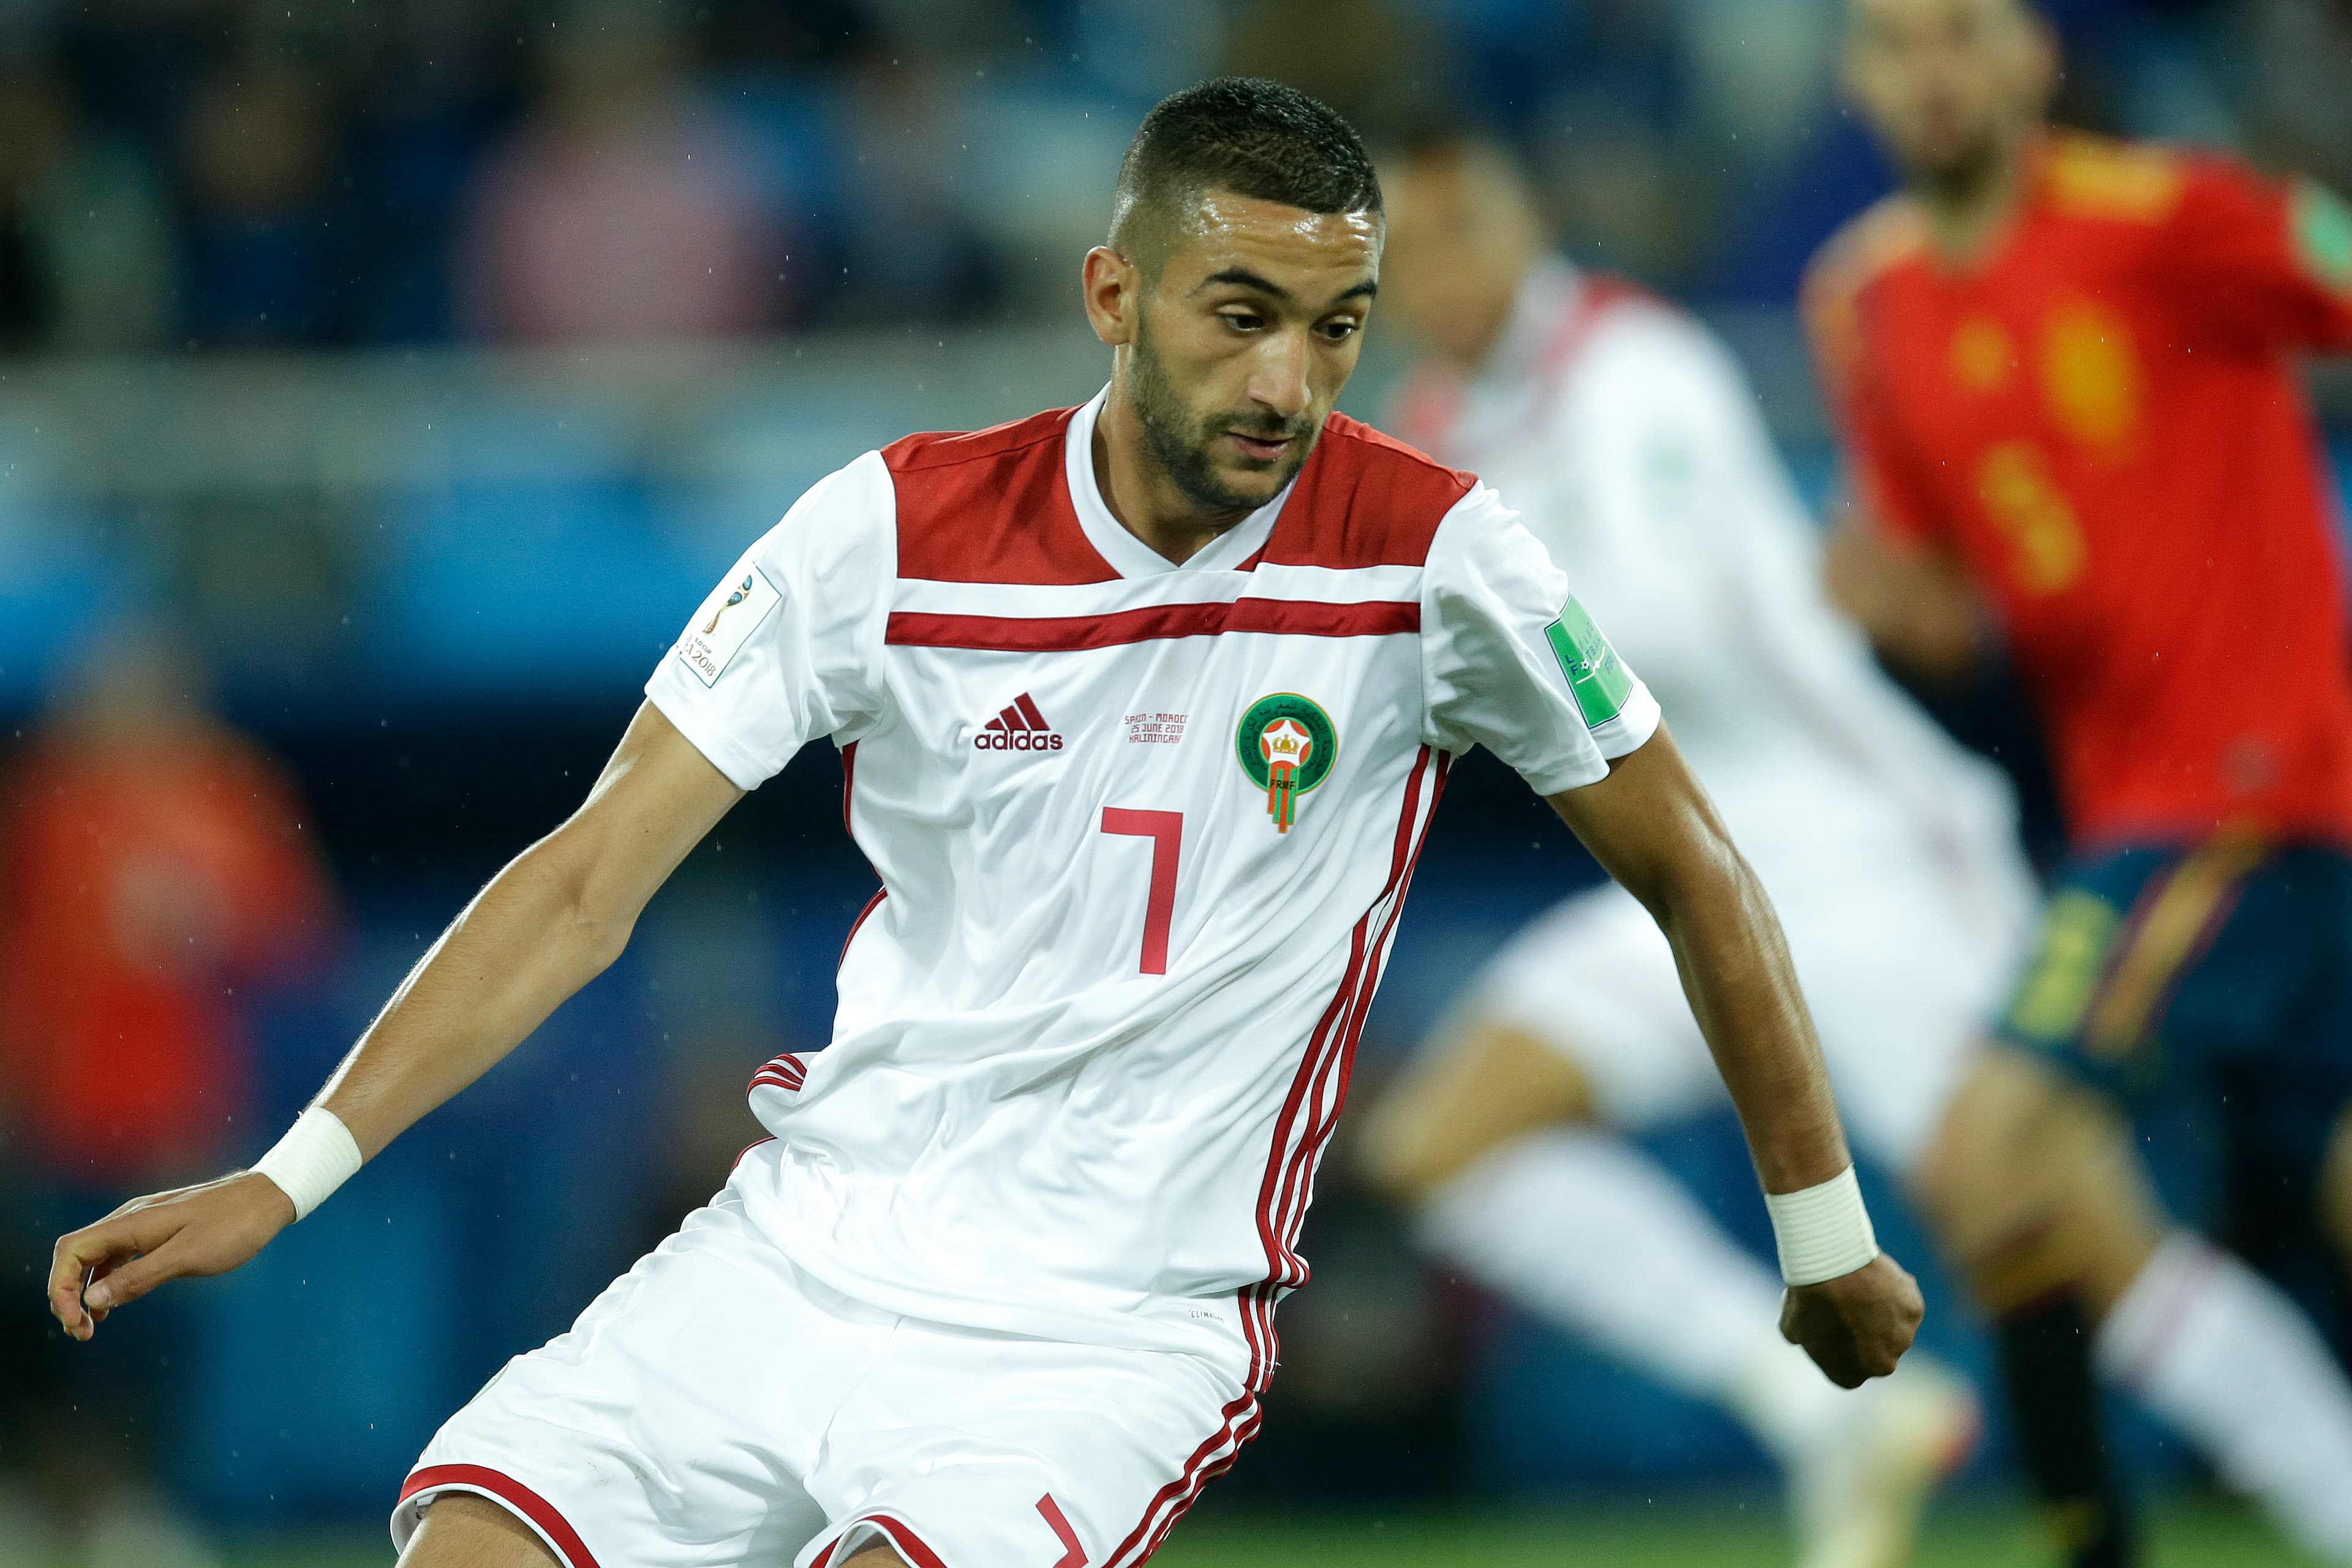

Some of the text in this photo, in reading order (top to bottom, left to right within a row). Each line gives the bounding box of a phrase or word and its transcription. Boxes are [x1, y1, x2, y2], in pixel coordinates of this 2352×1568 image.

[692, 650, 715, 676] 2018
[1125, 714, 1146, 724] SPAIN
[1142, 723, 1163, 732] JUNE
[1166, 725, 1184, 733] 2018
[974, 729, 1063, 750] adidas
[1270, 779, 1294, 789] FRMF
[1101, 806, 1183, 974] 7
